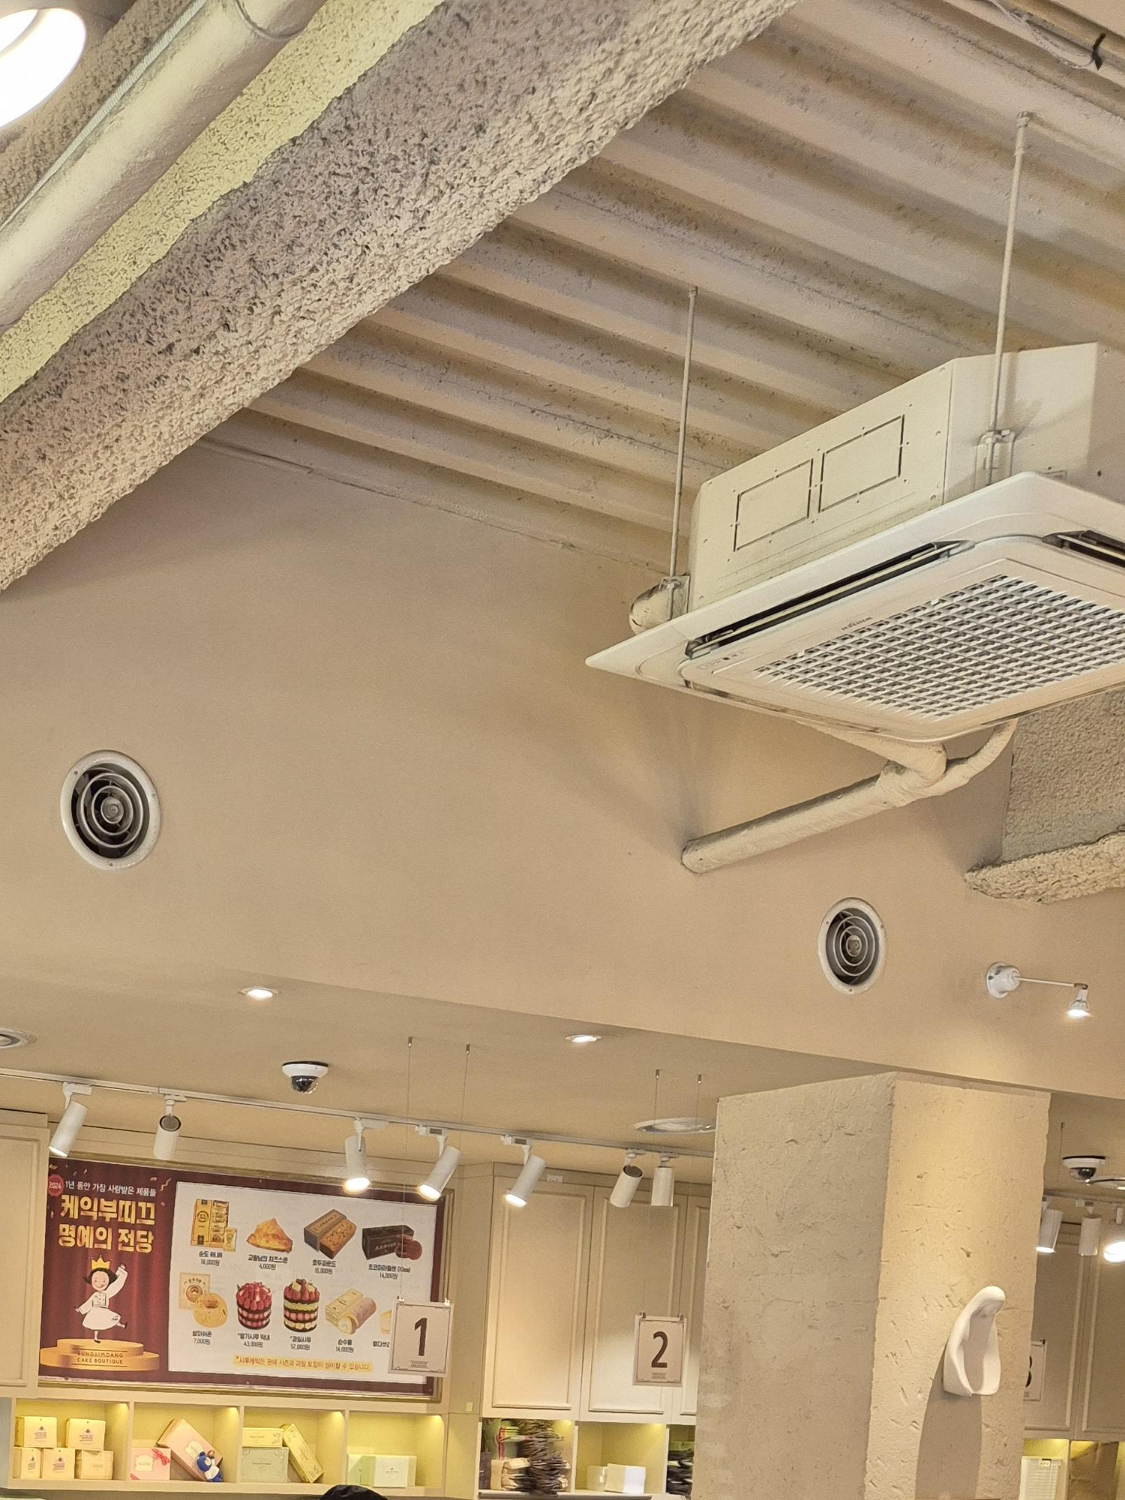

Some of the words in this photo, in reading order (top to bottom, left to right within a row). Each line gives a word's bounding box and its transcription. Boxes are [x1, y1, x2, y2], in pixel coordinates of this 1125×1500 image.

[65, 1181, 75, 1189] 1년
[77, 1182, 90, 1191] 동안
[92, 1183, 106, 1192] 가장
[108, 1185, 135, 1195] 사랑받은
[60, 1194, 156, 1225] 케익부띠끄
[58, 1223, 113, 1250] 명예의
[117, 1228, 154, 1253] 전당
[414, 1317, 428, 1356] 1
[651, 1331, 668, 1368] 2
